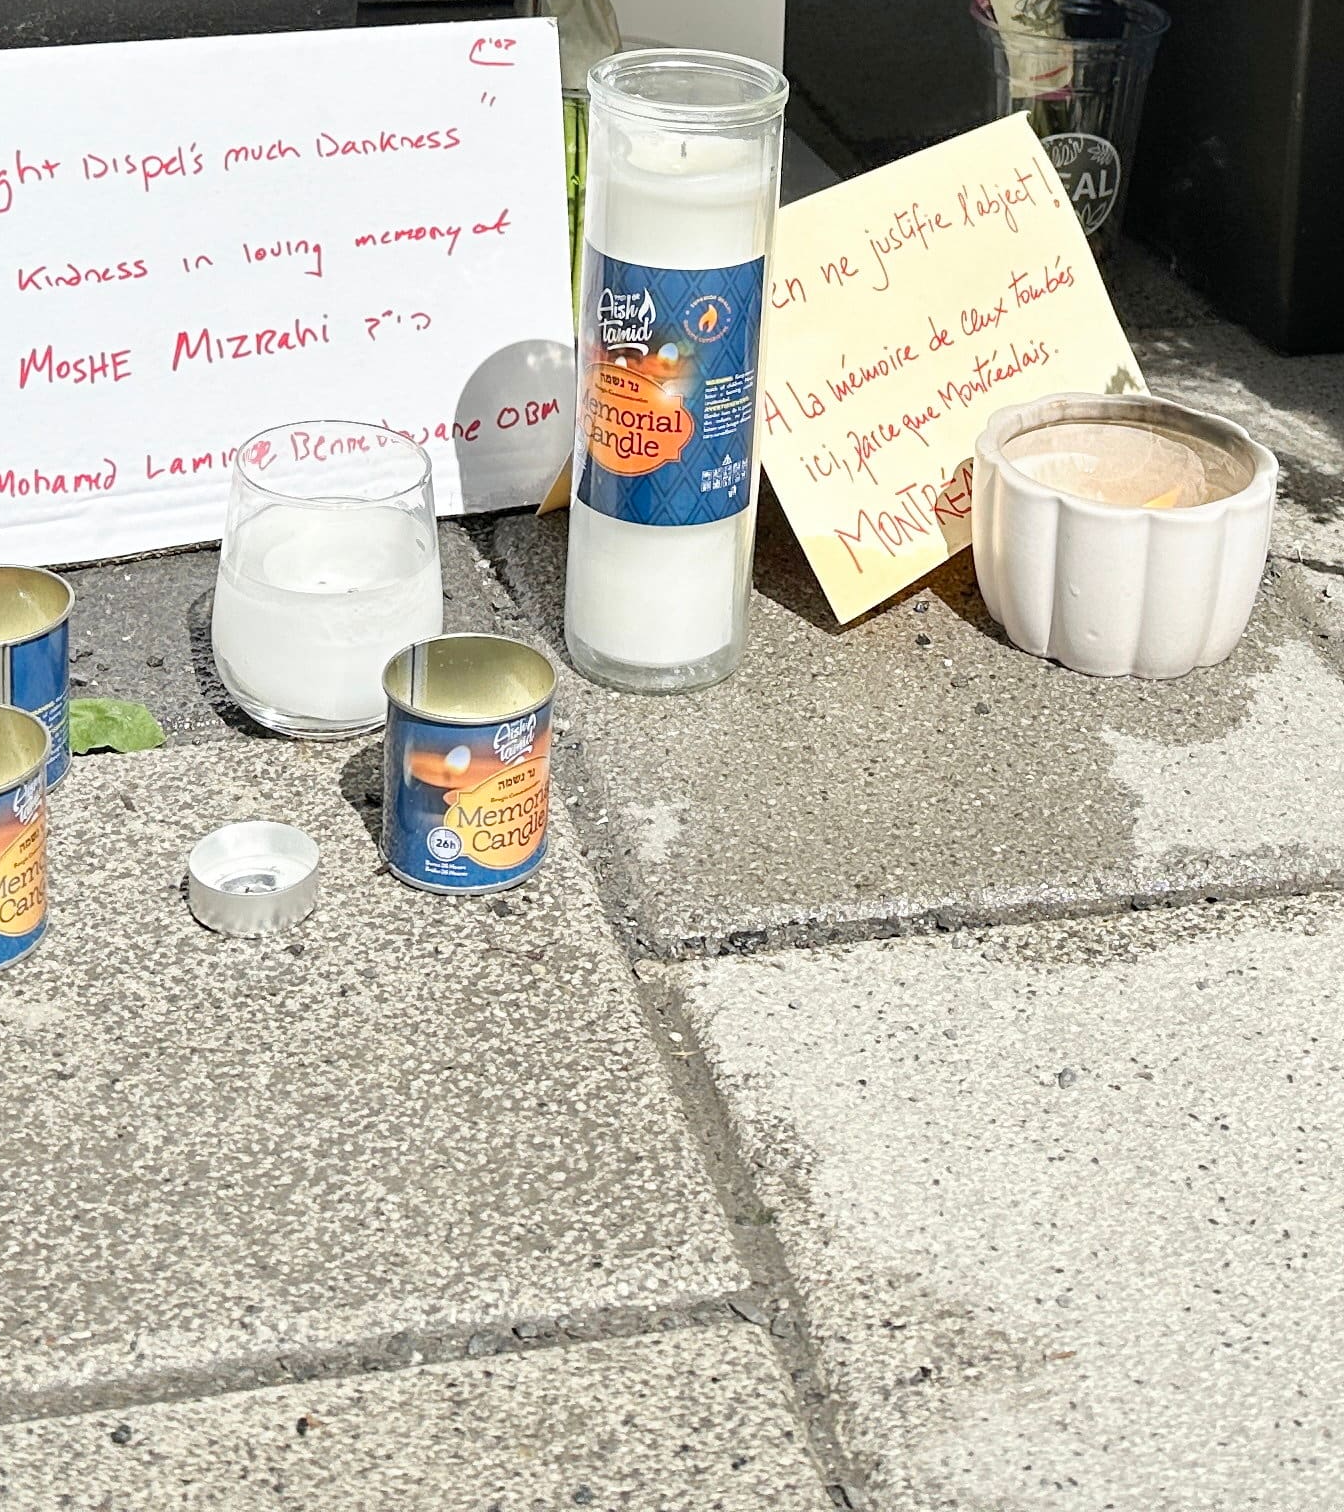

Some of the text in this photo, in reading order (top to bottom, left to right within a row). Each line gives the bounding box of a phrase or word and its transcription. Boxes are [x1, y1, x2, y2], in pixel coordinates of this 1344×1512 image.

[224, 139, 301, 172] much
[242, 239, 322, 278] loving
[819, 256, 859, 287] ne
[864, 202, 953, 291] justifie
[786, 381, 826, 419] la
[826, 345, 919, 403] mémoire
[928, 315, 955, 351] de
[496, 398, 560, 431] OBM
[902, 405, 941, 447] que
[435, 838, 456, 849] 26h
[472, 809, 546, 853] Candle
